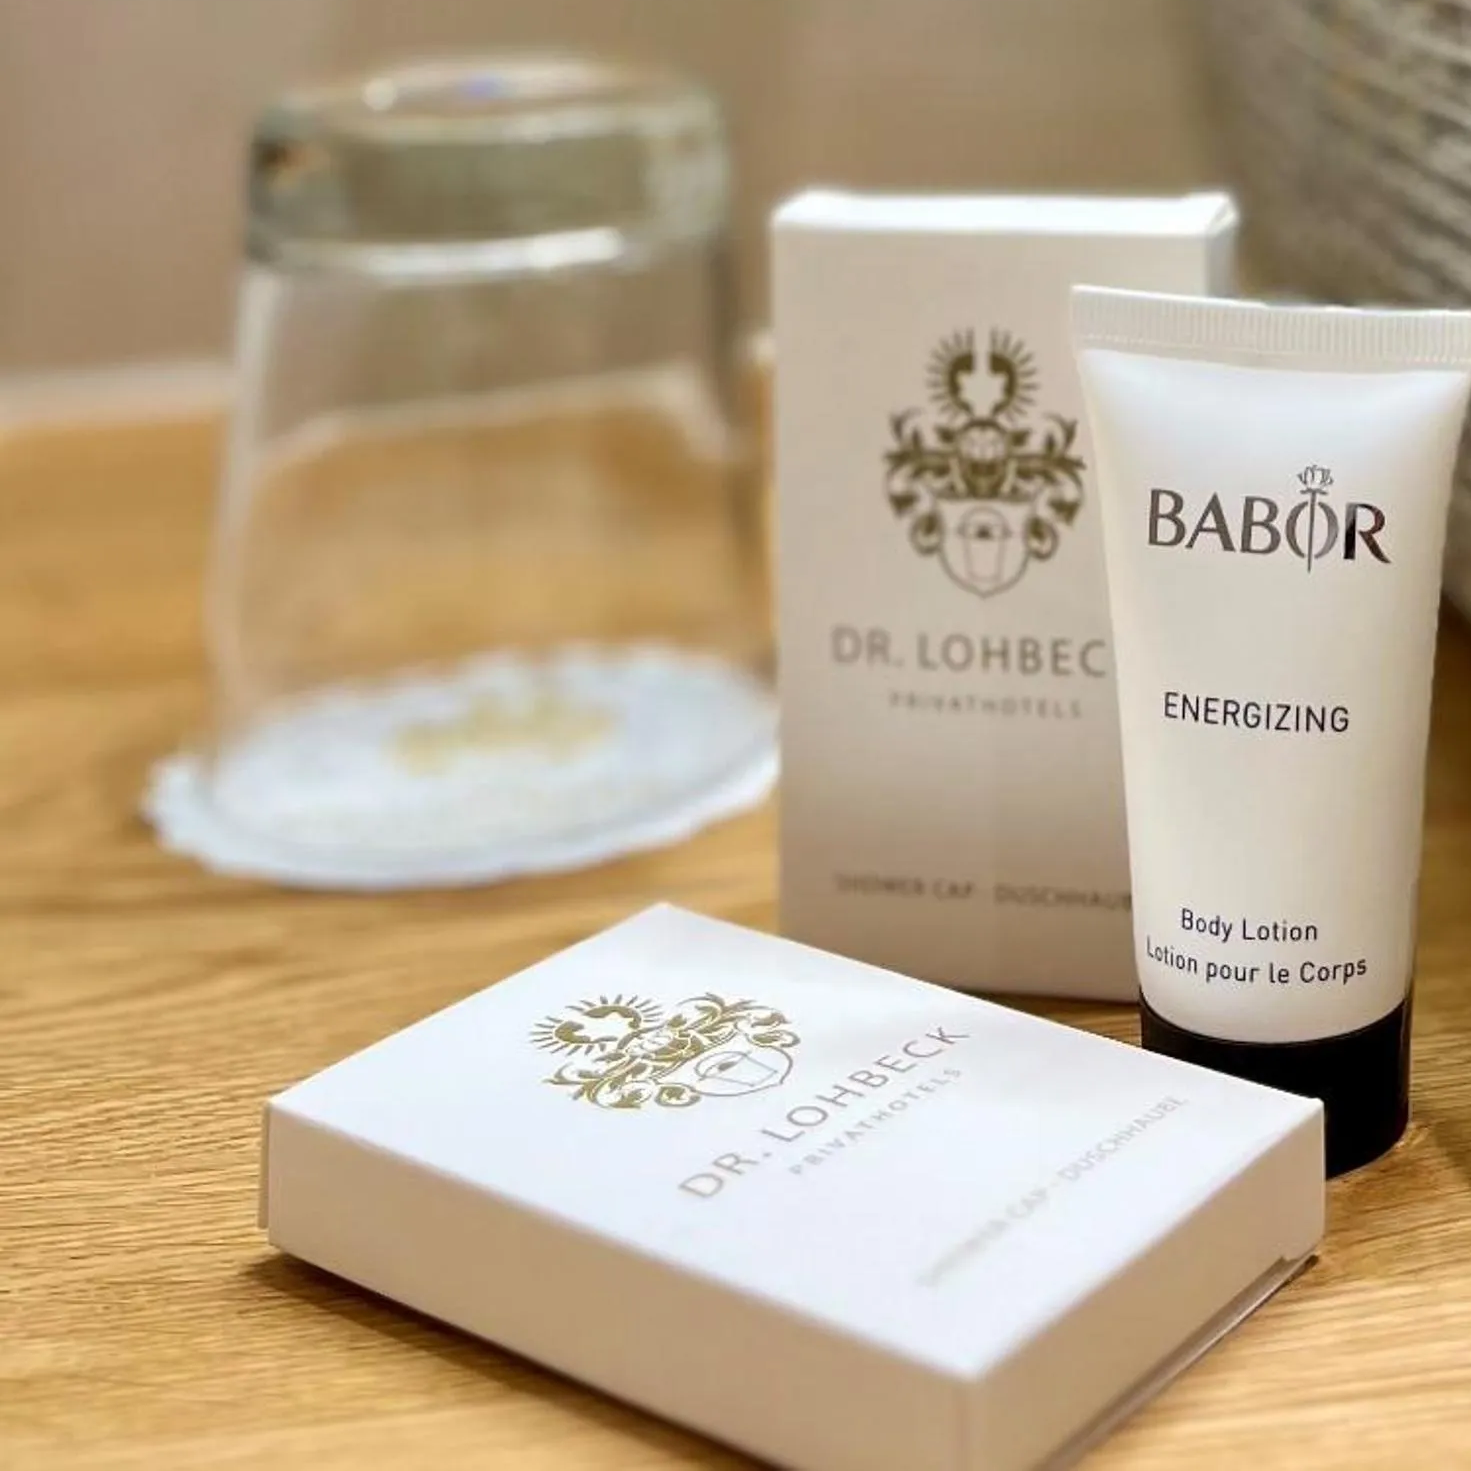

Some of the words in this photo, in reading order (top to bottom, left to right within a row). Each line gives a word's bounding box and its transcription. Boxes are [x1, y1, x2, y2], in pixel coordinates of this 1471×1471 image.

[1148, 465, 1392, 573] BABOR
[831, 625, 904, 669] DR.
[916, 632, 1108, 678] LOHBEC
[888, 689, 1082, 719] PRIVATHOTELS
[1163, 691, 1350, 733] ENERGIZING
[994, 882, 1132, 913] DUSCHHAUB
[1181, 907, 1233, 943] Body
[1242, 918, 1318, 941] Lotion
[1146, 935, 1198, 974] Lotion
[1205, 961, 1260, 983] pour
[1269, 962, 1290, 984] le
[1300, 958, 1368, 986] Corps
[679, 1150, 772, 1198] DR.
[760, 1026, 971, 1143] LOHBECK
[788, 1067, 963, 1175] PRIVATHOTELS
